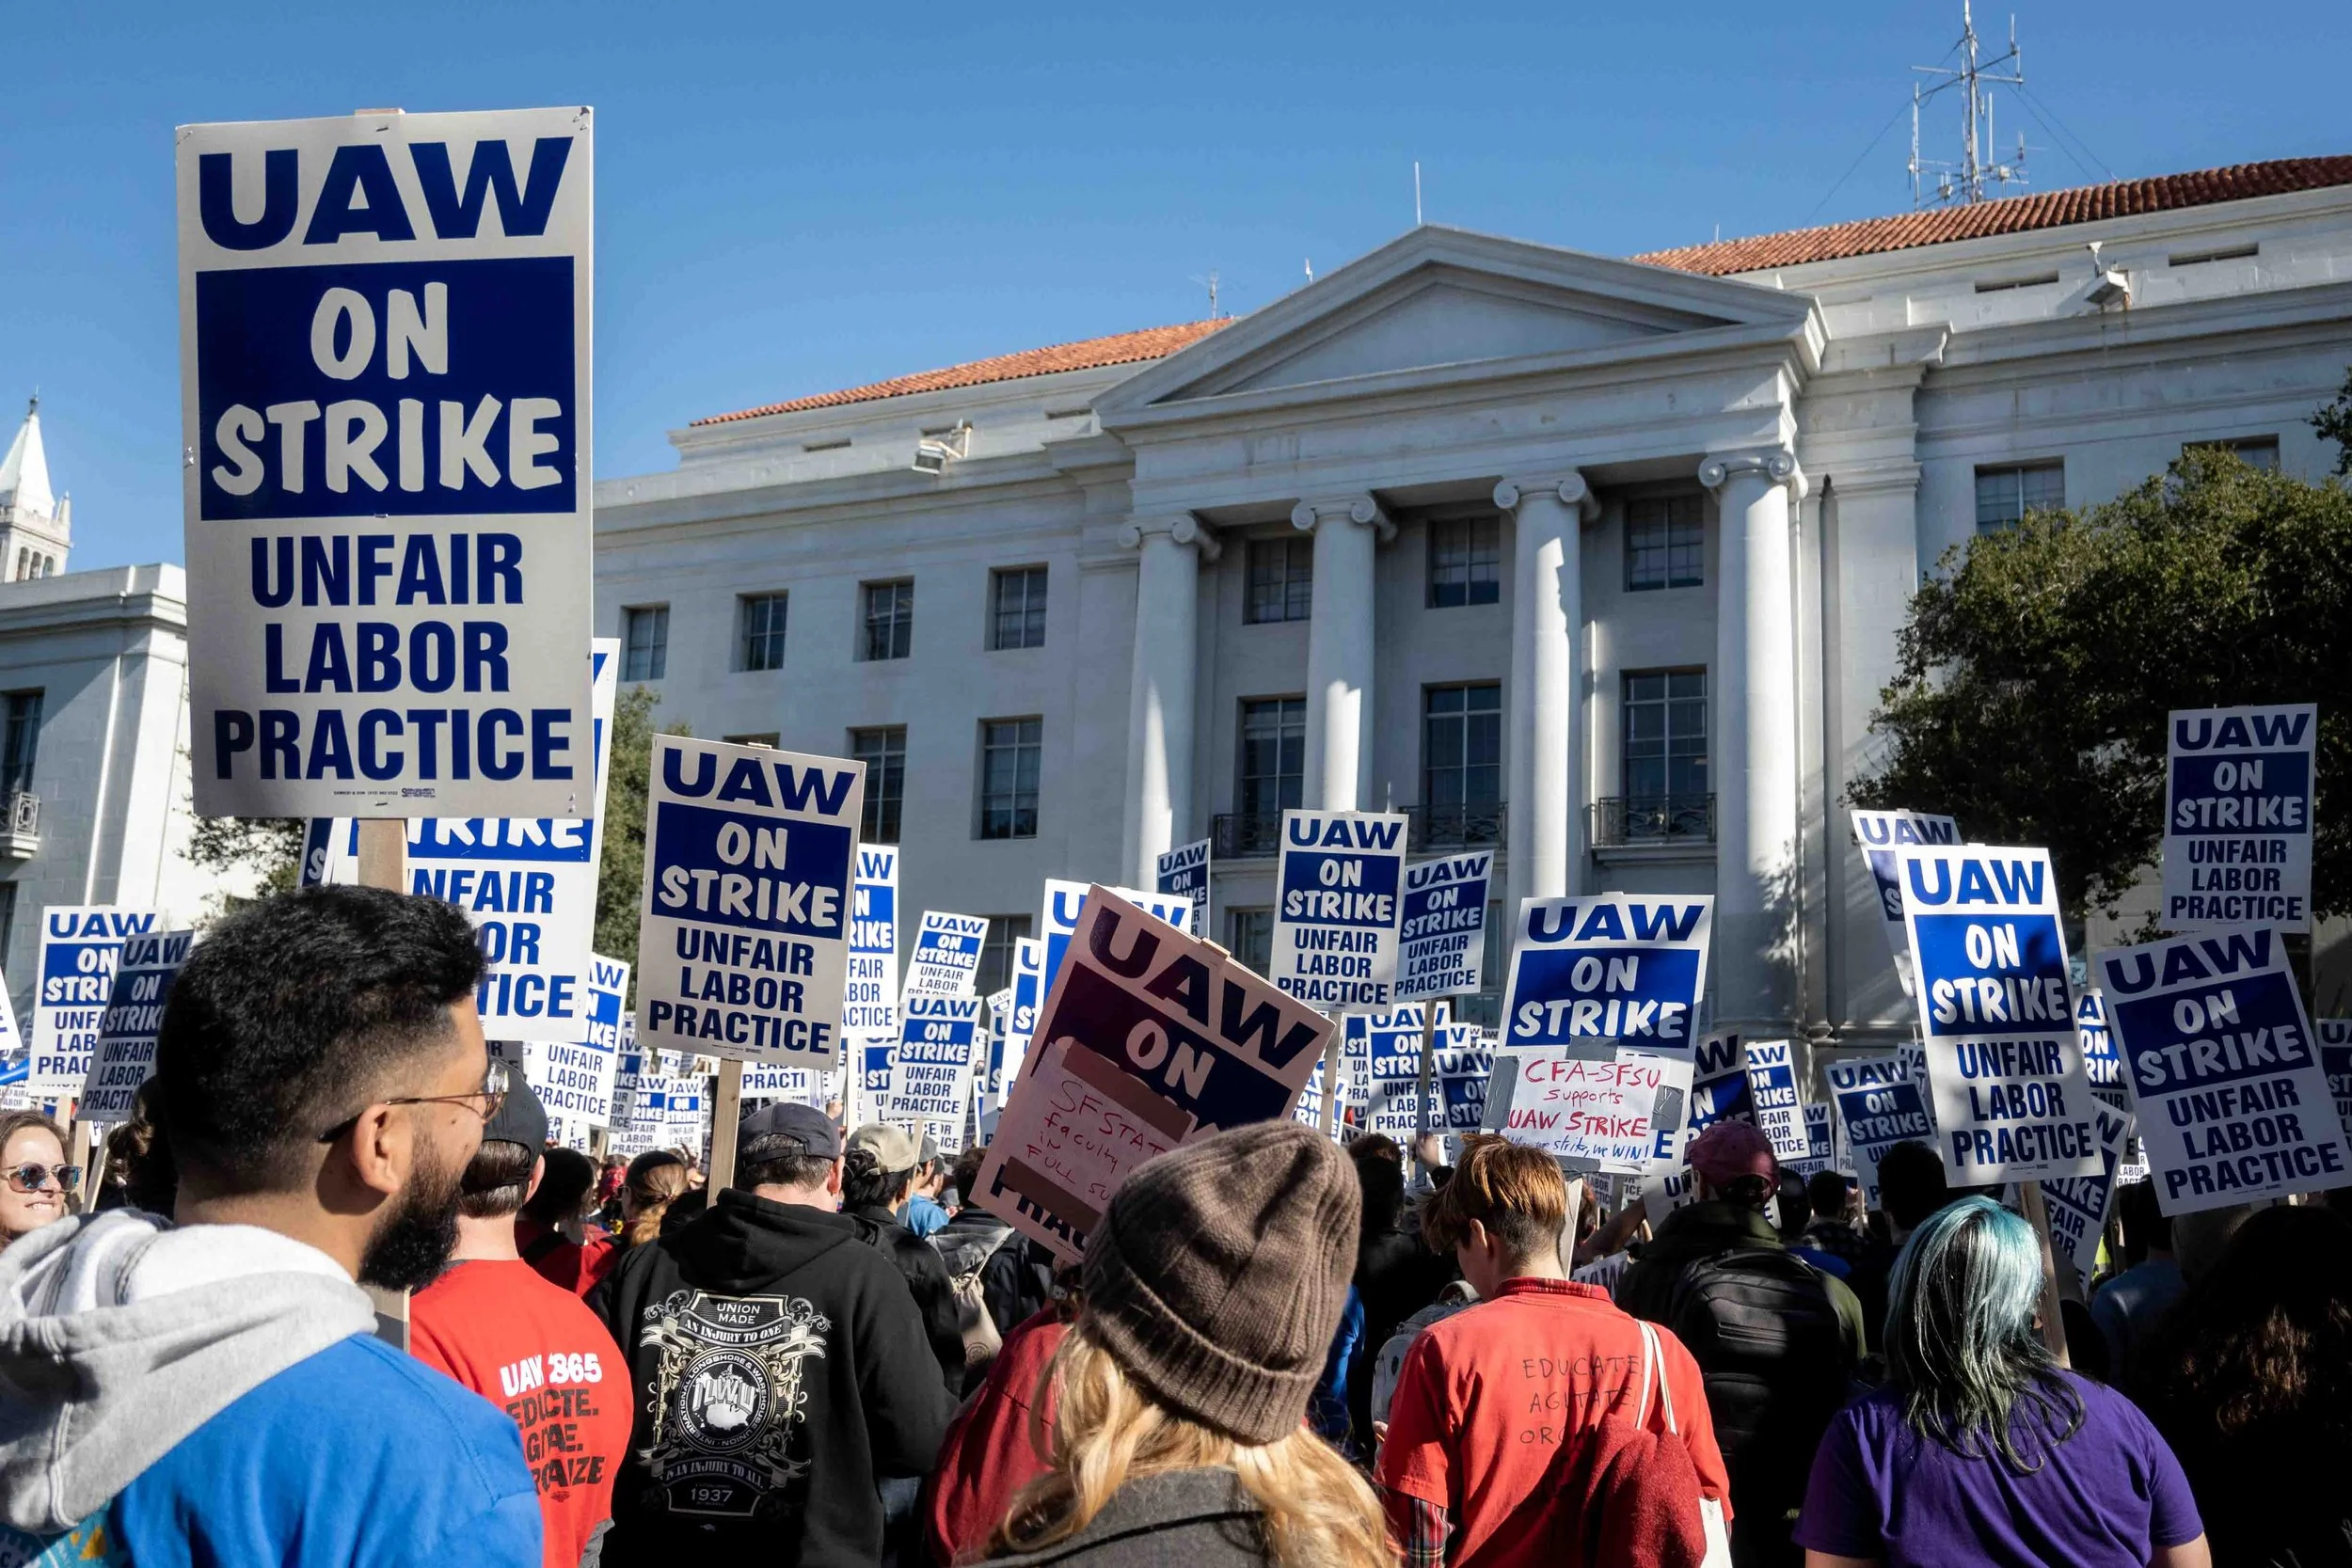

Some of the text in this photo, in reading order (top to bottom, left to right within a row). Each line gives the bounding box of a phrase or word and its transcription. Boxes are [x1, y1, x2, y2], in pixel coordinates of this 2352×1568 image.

[199, 136, 574, 251] UAW
[310, 282, 448, 380] ON
[212, 393, 563, 496] STRIKE
[251, 533, 523, 609] UNFAIR
[265, 621, 510, 693] LABOR
[215, 707, 573, 781] PRACTICE
[2176, 713, 2311, 751] UAW
[663, 747, 857, 816] UAW
[2213, 759, 2264, 791] ON
[2175, 796, 2303, 829] STRIKE
[1288, 817, 1402, 850] UAW
[1860, 816, 1953, 845] UAW
[716, 821, 788, 870] ON
[2188, 839, 2287, 863] UNFAIR
[1159, 845, 1208, 874] UAW
[1319, 859, 1362, 887] ON
[1406, 856, 1490, 889] UAW
[408, 868, 555, 914] NFAIR
[1172, 871, 1192, 891] ON
[1906, 857, 2044, 906] UAW
[2191, 867, 2280, 892] LABOR
[659, 865, 839, 927] STRIKE
[1283, 889, 1393, 922] STRIKE
[1426, 886, 1458, 911] ON
[2170, 895, 2303, 921] PRACTICE
[50, 913, 156, 938] UAW
[850, 920, 893, 949] RIKE
[926, 915, 984, 934] UAW
[1403, 907, 1481, 940] STRIKE
[1528, 904, 1706, 942] UAW
[122, 935, 193, 967] UAW
[675, 927, 815, 976] UNFAIR
[937, 934, 960, 951] ON
[1295, 927, 1378, 954] UNFAIR
[1407, 934, 1469, 959] UNFAIR
[1964, 923, 2021, 970] ON
[77, 947, 119, 980] ON
[849, 958, 884, 979] FAIR
[915, 947, 976, 970] STRIKE
[1296, 954, 1372, 978] LABOR
[1407, 954, 1463, 976] LABOR
[2106, 928, 2272, 995] UAW
[918, 977, 959, 992] LABOR
[919, 966, 964, 980] UNFAIR
[1394, 969, 1476, 997] PRACTICE
[1570, 956, 1639, 992] ON
[45, 975, 108, 1002] STRI
[131, 974, 162, 1002] ON
[476, 974, 576, 1018] TICE
[679, 967, 804, 1013] LABOR
[845, 983, 881, 1003] BOR
[1089, 905, 1319, 1070] UAW
[1278, 977, 1389, 1006] PRACTICE
[1931, 975, 2069, 1025] STRIKE
[55, 1011, 105, 1030] UNF
[105, 1005, 166, 1032] STRIK
[843, 1007, 893, 1027] CTICE
[909, 998, 977, 1018] UAW
[1514, 999, 1687, 1038] STRIKE
[2172, 990, 2241, 1035] ON
[648, 1000, 832, 1054] PRACTICE
[924, 1022, 953, 1041] ON
[56, 1033, 97, 1053] LAB
[103, 1041, 155, 1063] UNFAIR
[900, 1041, 969, 1063] STRIKE
[1393, 1034, 1423, 1054] ON
[1746, 1045, 1786, 1065] AW
[2137, 1024, 2305, 1086] STRIKE
[38, 1056, 91, 1074] PRAC
[548, 1045, 604, 1073] UNFAIR
[1126, 1019, 1216, 1100] ON
[1374, 1056, 1420, 1076] STRI
[1956, 1039, 2064, 1080] UNFAIR
[98, 1066, 147, 1086] LABOR
[548, 1066, 598, 1093] LABOR
[638, 1077, 666, 1090] AW
[742, 1072, 805, 1089] PRACTI
[905, 1067, 957, 1082] UNFAIR
[1525, 1059, 1661, 1089] CFA-SFSU
[1830, 1060, 1909, 1090] UAW
[83, 1089, 138, 1110] PRACT
[533, 1085, 608, 1116] PRACTICE
[904, 1082, 952, 1098] LABOR
[1383, 1082, 1439, 1096] UNFR
[1755, 1087, 1795, 1107] RIKE
[1865, 1090, 1898, 1115] ON
[1969, 1081, 2067, 1122] LABOR
[632, 1107, 664, 1121] RIKE
[891, 1097, 961, 1115] PRACTICE
[1388, 1098, 1438, 1113] LABR
[1451, 1103, 1483, 1123] STR
[2167, 1078, 2301, 1128] UNFAIR
[610, 1116, 629, 1127] TICE
[630, 1124, 657, 1132] FAIR
[1507, 1109, 1562, 1130] UAW
[1760, 1110, 1791, 1126] FAIR
[1850, 1112, 1928, 1142] STRIKE
[620, 1134, 653, 1144] LABOR
[1765, 1125, 1791, 1140] BOR
[1773, 1138, 1805, 1154] TICE
[1951, 1121, 2095, 1168] PRACTICE
[2182, 1114, 2305, 1161] LABOR
[1026, 1144, 1076, 1185] FULL
[1612, 1143, 1649, 1164] WIN!
[2165, 1141, 2345, 1200] PRACTICE
[2049, 1201, 2087, 1240] FAIR
[717, 1303, 760, 1314] UNION
[718, 1313, 756, 1324] MADE
[685, 1319, 783, 1343] AN INJURY TO ONE
[689, 1354, 746, 1379] LONGSHORE
[752, 1368, 767, 1430] WAREHOUSE
[679, 1379, 715, 1447] INTERNATIONAL
[722, 1429, 755, 1447] UNION
[691, 1461, 730, 1473] INJURY
[732, 1463, 745, 1477] TO
[691, 1488, 733, 1502] 1937
